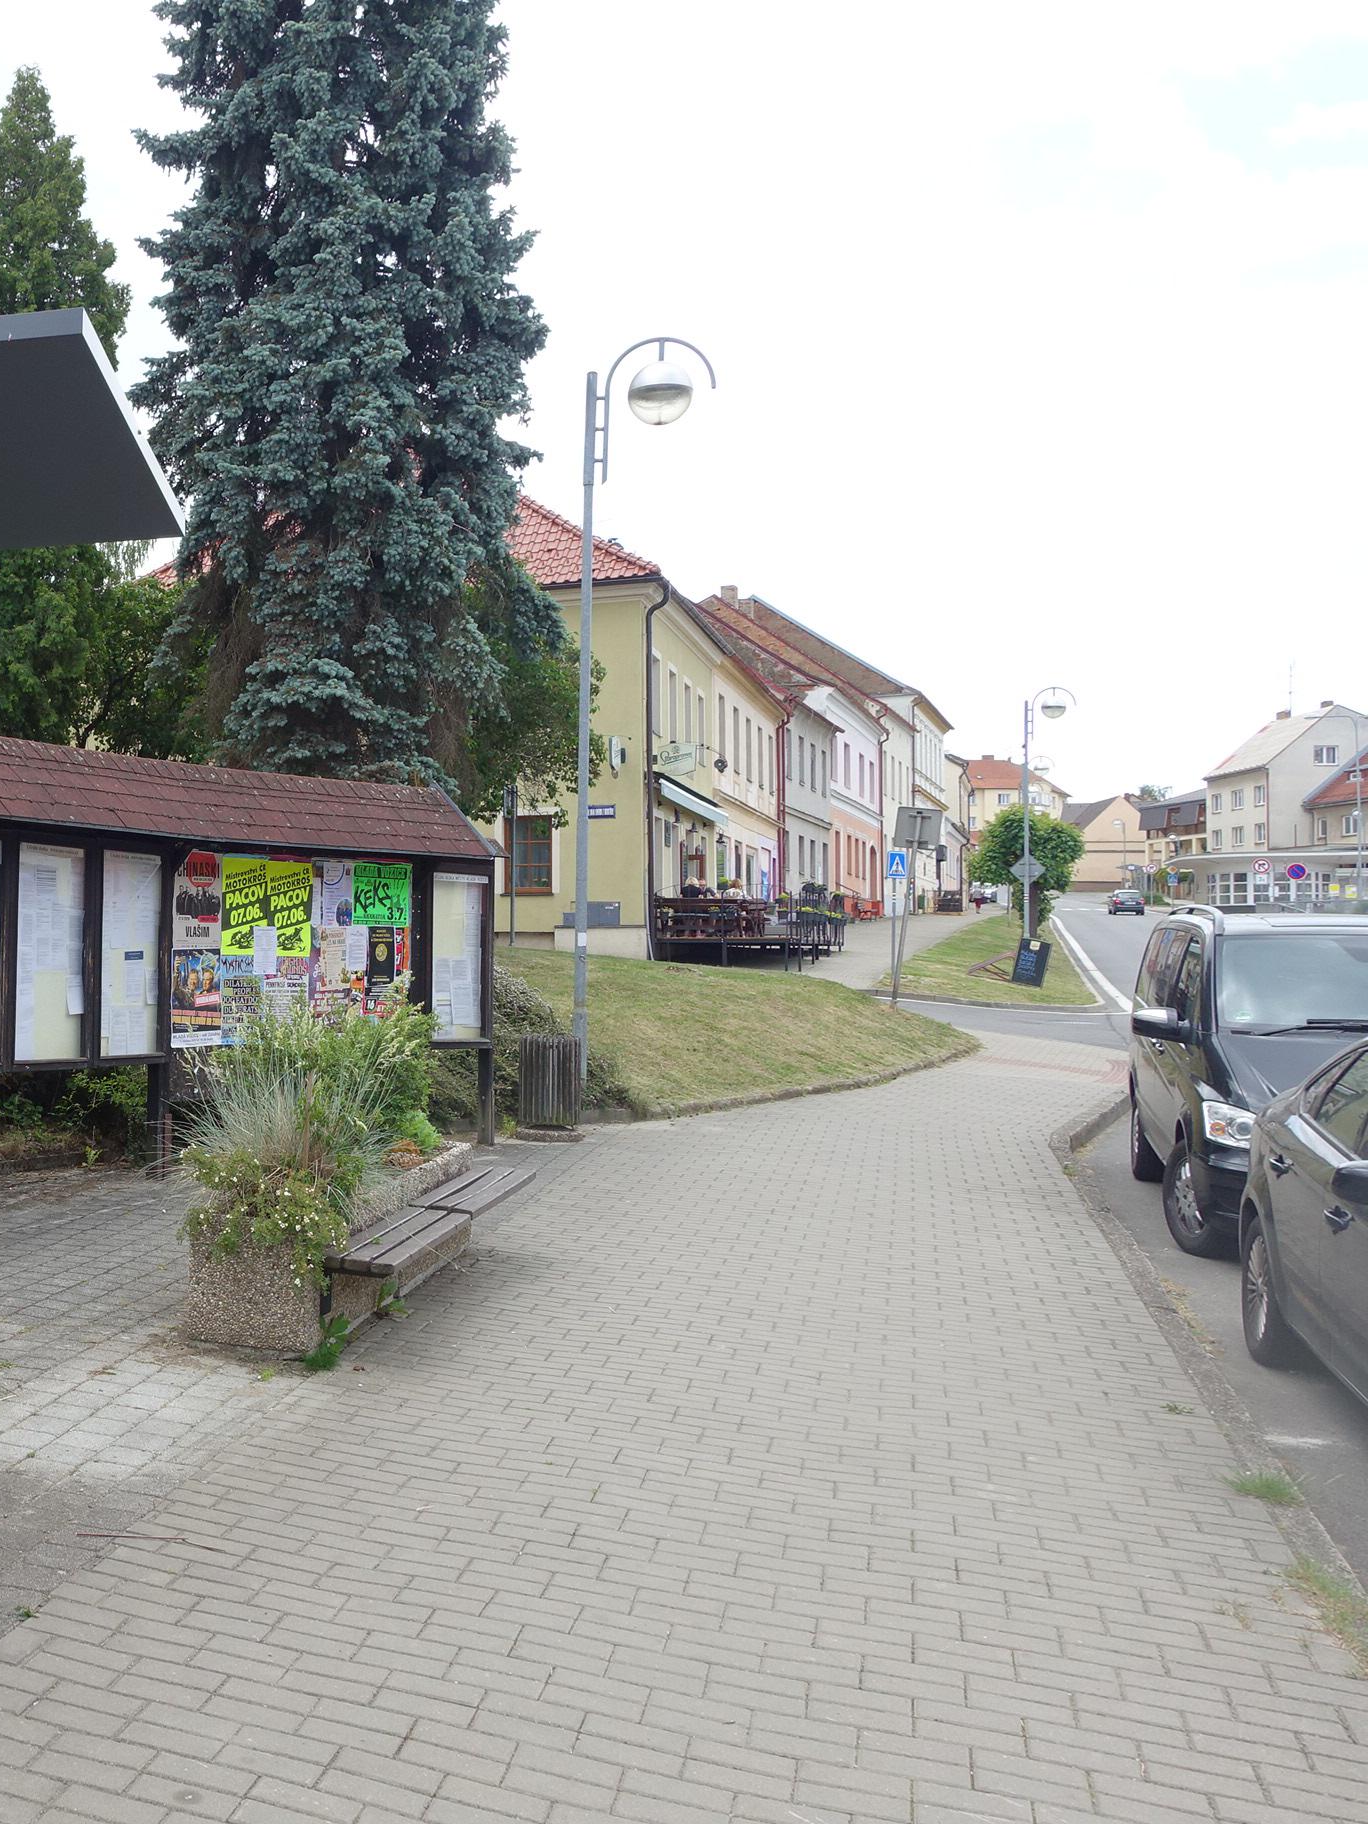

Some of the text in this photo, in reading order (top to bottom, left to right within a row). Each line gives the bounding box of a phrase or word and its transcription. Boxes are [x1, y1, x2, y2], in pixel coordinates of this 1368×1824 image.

[225, 872, 267, 891] MOTOKROS
[270, 876, 310, 893] MOTOKROS
[225, 883, 266, 909] PACOV
[270, 886, 310, 911] PACOV
[354, 880, 392, 913] KEKS
[230, 904, 263, 926] 07.06.
[274, 906, 307, 928] 07.06.
[387, 907, 407, 921] 3.7.
[185, 925, 210, 938] VLAŠIM
